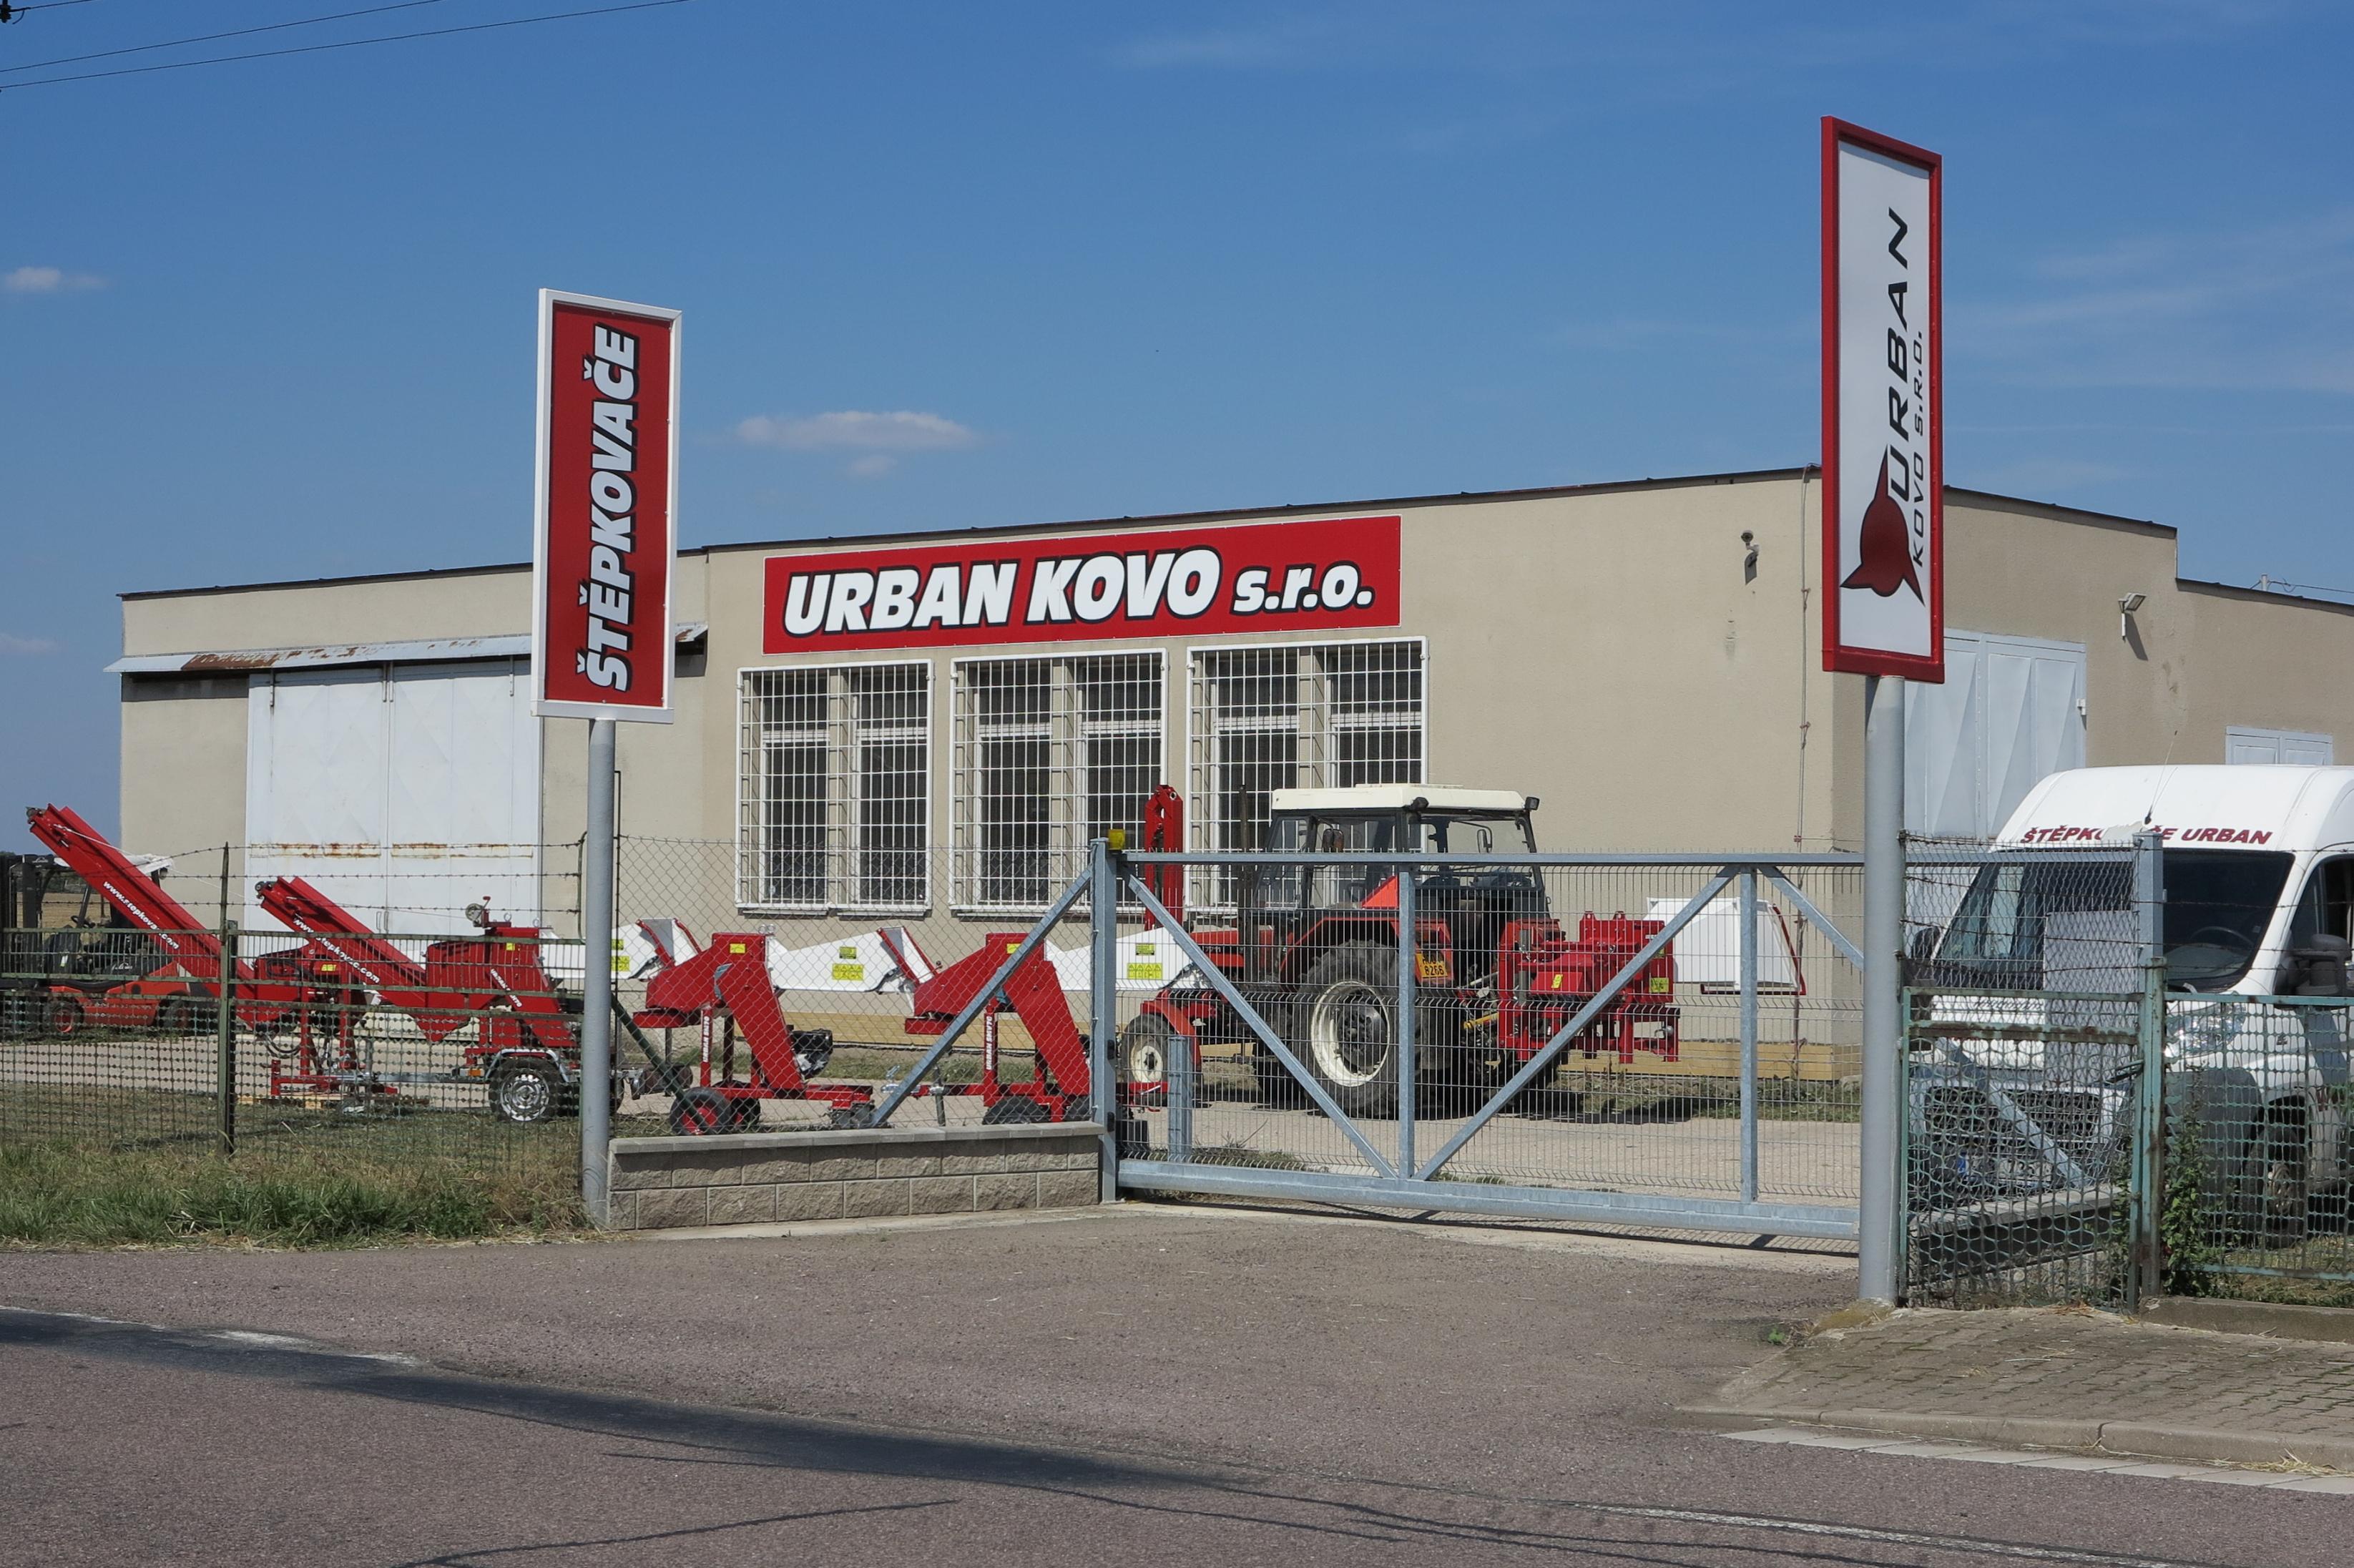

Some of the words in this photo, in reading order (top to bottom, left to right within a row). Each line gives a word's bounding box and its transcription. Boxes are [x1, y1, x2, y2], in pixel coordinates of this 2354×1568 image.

[1887, 207, 1909, 502] URBAN
[1913, 332, 1923, 436] S.R.O.
[577, 325, 635, 692] ŠTĚPKOVAČE
[1913, 452, 1924, 567] KOVO
[783, 562, 1019, 636] URBAN
[1025, 549, 1222, 623] KOVO
[1232, 564, 1373, 614] s.r.o.
[2182, 828, 2273, 845] URBAN
[104, 881, 180, 949] www.stepkova.com
